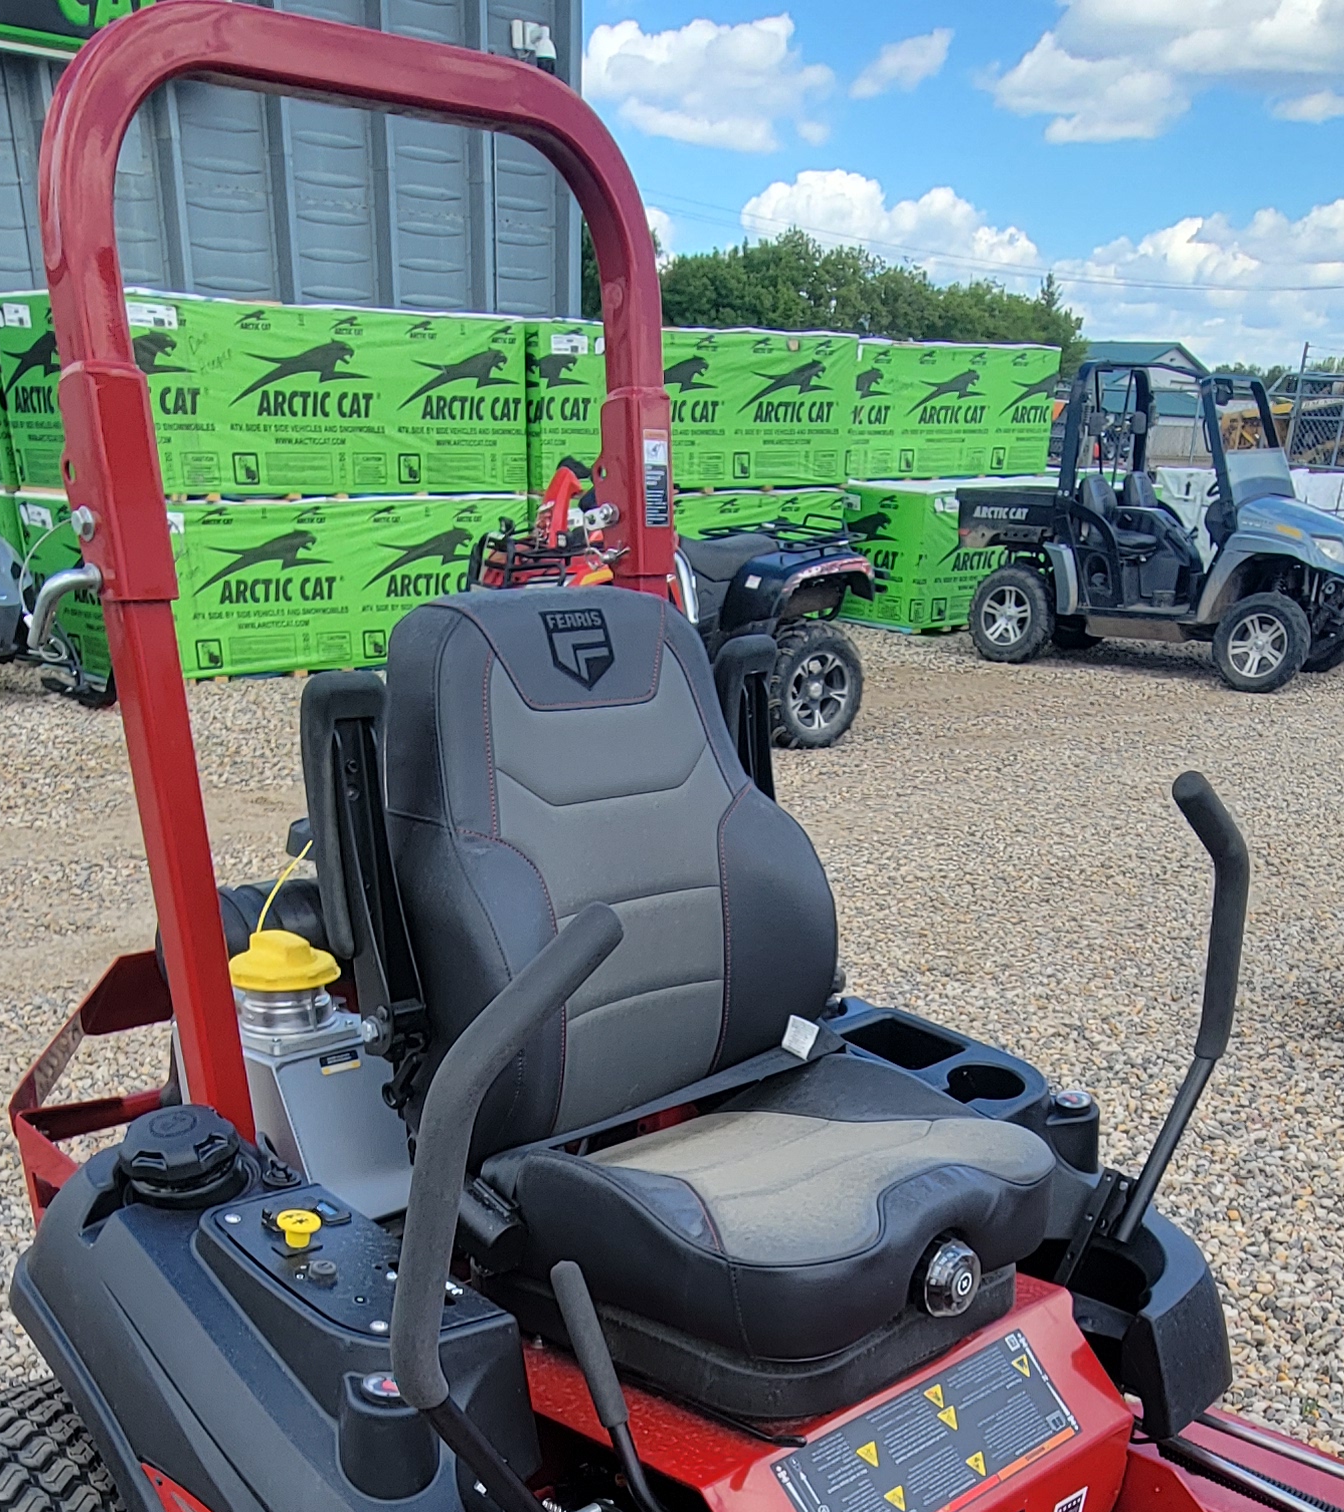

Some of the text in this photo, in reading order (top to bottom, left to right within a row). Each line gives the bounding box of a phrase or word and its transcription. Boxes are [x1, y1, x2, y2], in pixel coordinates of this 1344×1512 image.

[15, 385, 55, 414] ARCTIC
[160, 386, 200, 416] CAT
[258, 390, 374, 418] ARCTIC CAT
[422, 395, 522, 421] ARCTIC CAT
[560, 397, 591, 422] CAT
[691, 400, 719, 423] CAT
[753, 401, 834, 423] ARCTIC CAT
[867, 405, 891, 424] CAT
[918, 405, 986, 424] ARCTIC CAT
[1011, 405, 1050, 424] ARCTIC
[973, 506, 1029, 521] ARCTIC CAT
[874, 550, 898, 570] CAT
[952, 550, 996, 572] ARCTIC
[219, 575, 337, 605] ARCTIC CAT
[386, 572, 451, 598] ARCTIC
[546, 611, 601, 629] FERRIS
